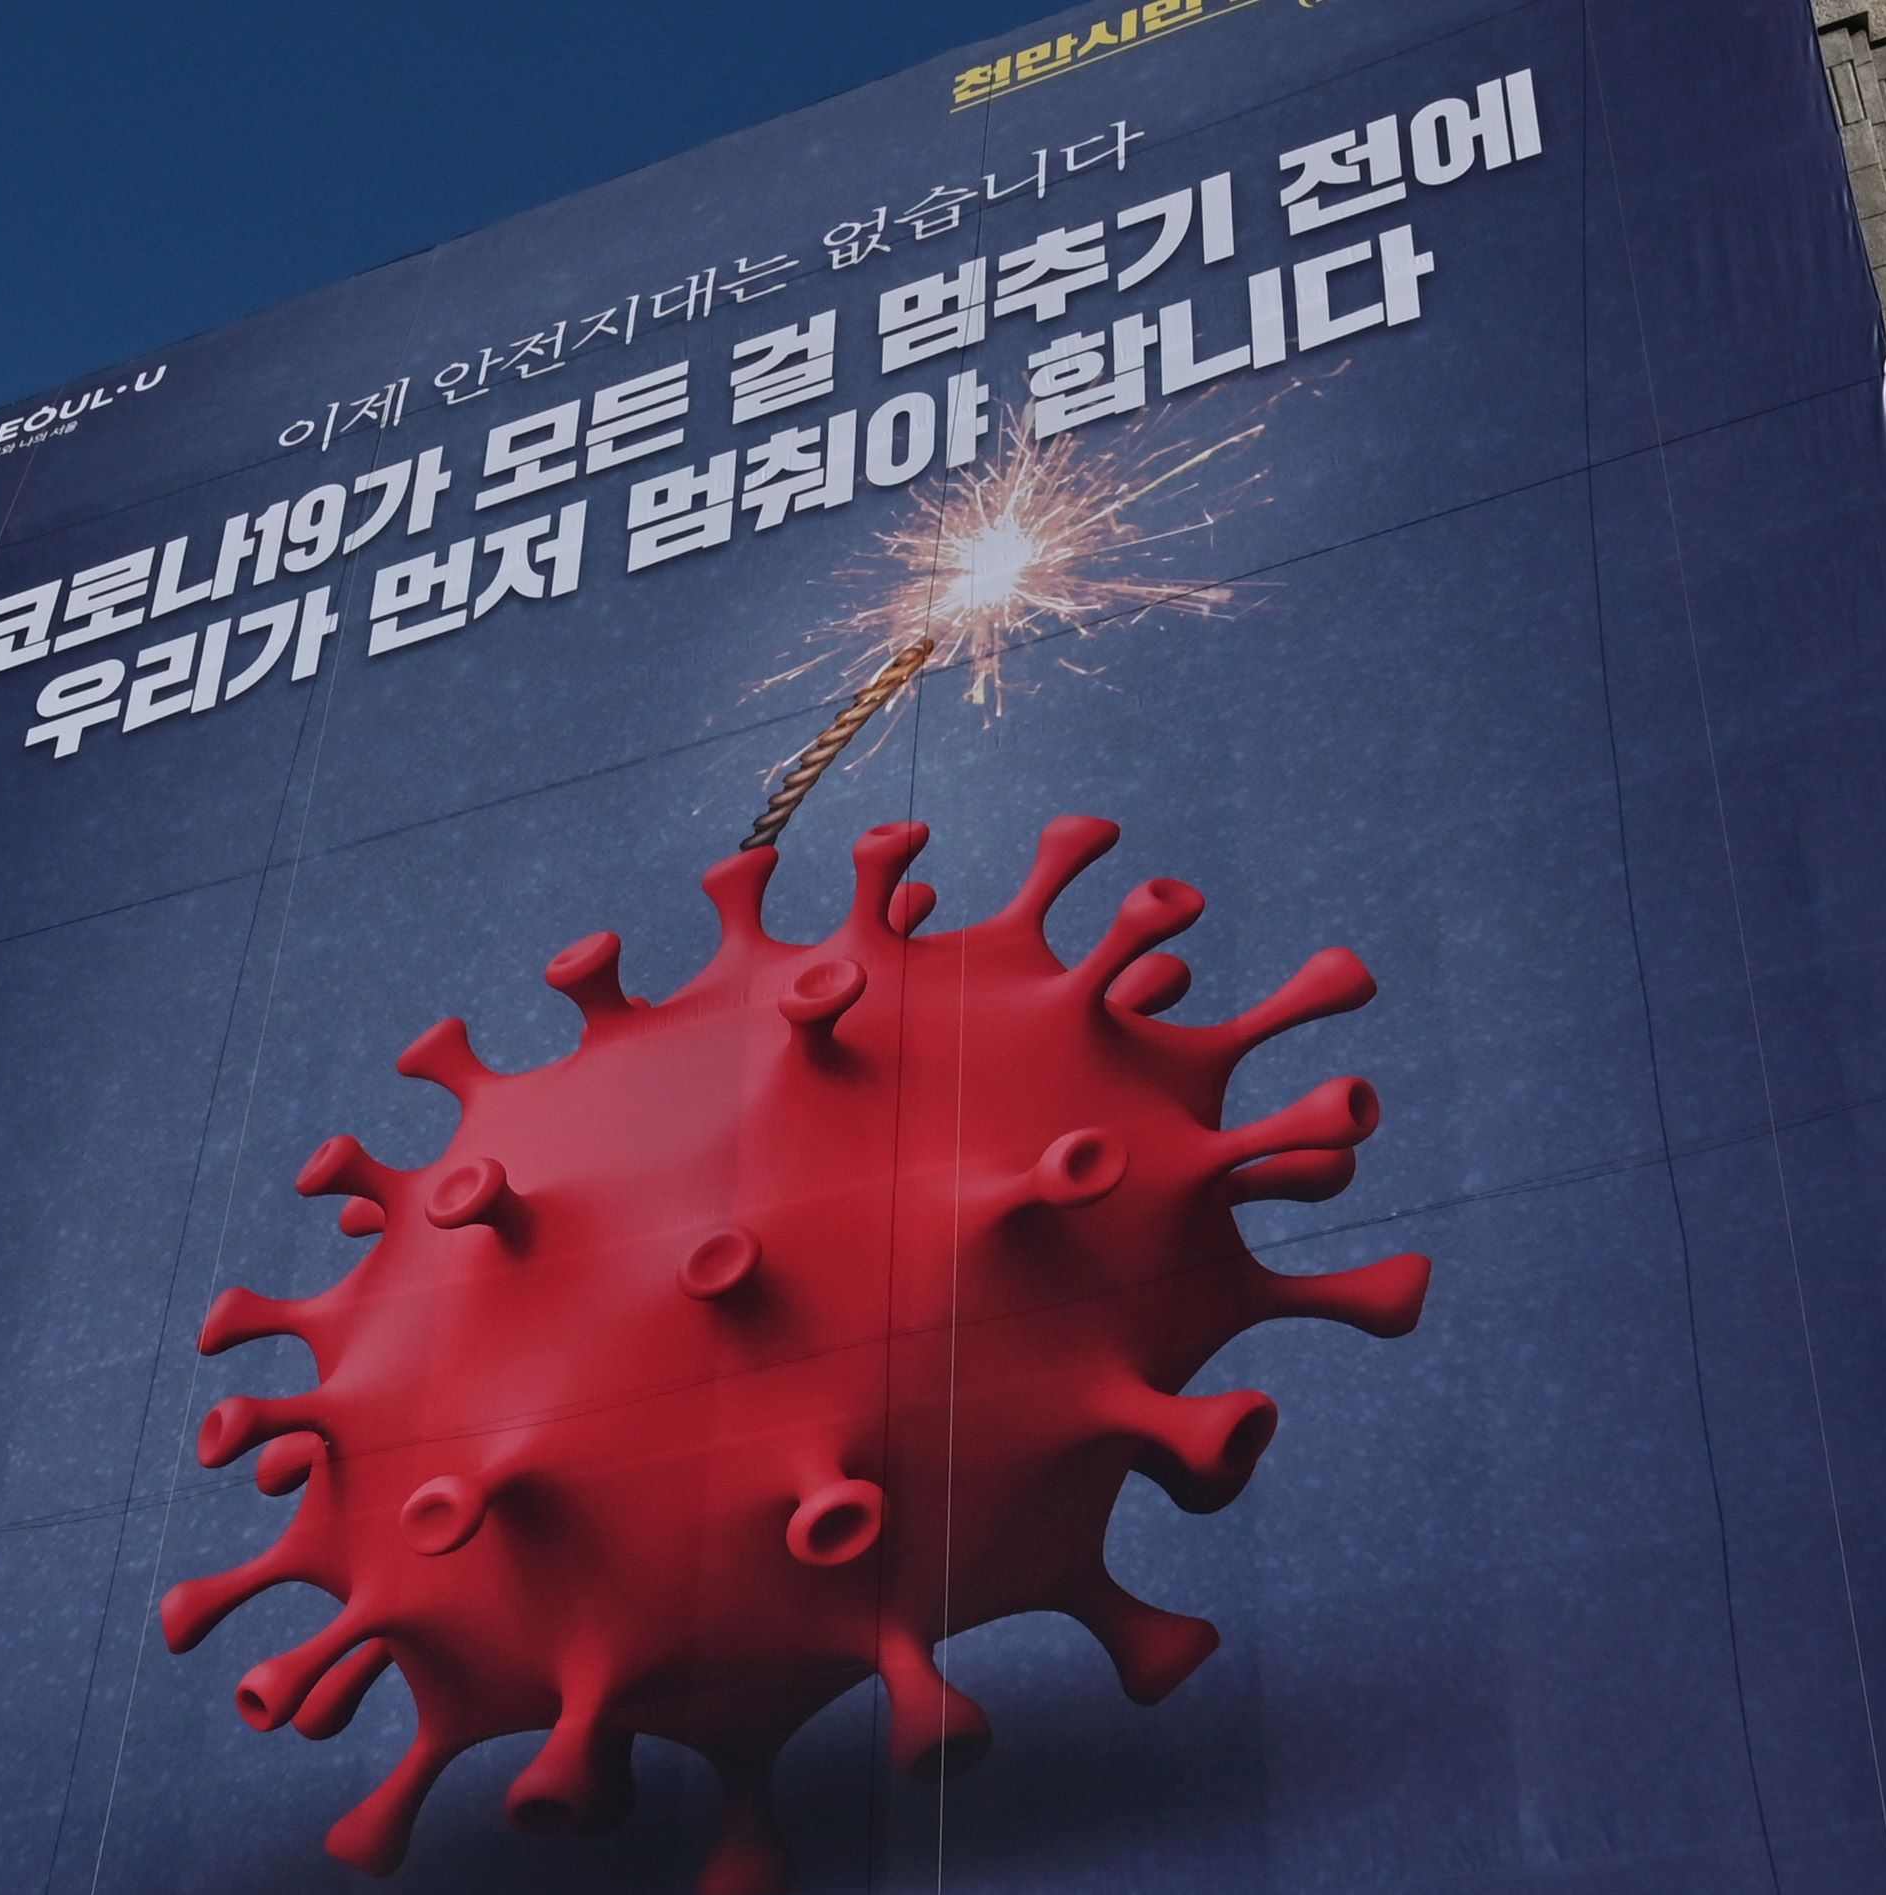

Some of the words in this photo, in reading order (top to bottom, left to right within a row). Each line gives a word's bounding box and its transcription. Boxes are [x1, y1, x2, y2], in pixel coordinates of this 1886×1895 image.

[25, 585, 338, 758] 우리가
[368, 500, 587, 656] 먼저
[627, 369, 989, 572] 멈춰야
[1025, 224, 1434, 440] 합니다
[279, 377, 410, 451] 이제
[434, 255, 799, 404] 안전지대는
[823, 120, 1144, 269] 없습니다
[475, 360, 689, 510] 모든
[730, 309, 836, 424] 걸
[879, 172, 1234, 374] 멈추기
[1279, 68, 1541, 235] 전에
